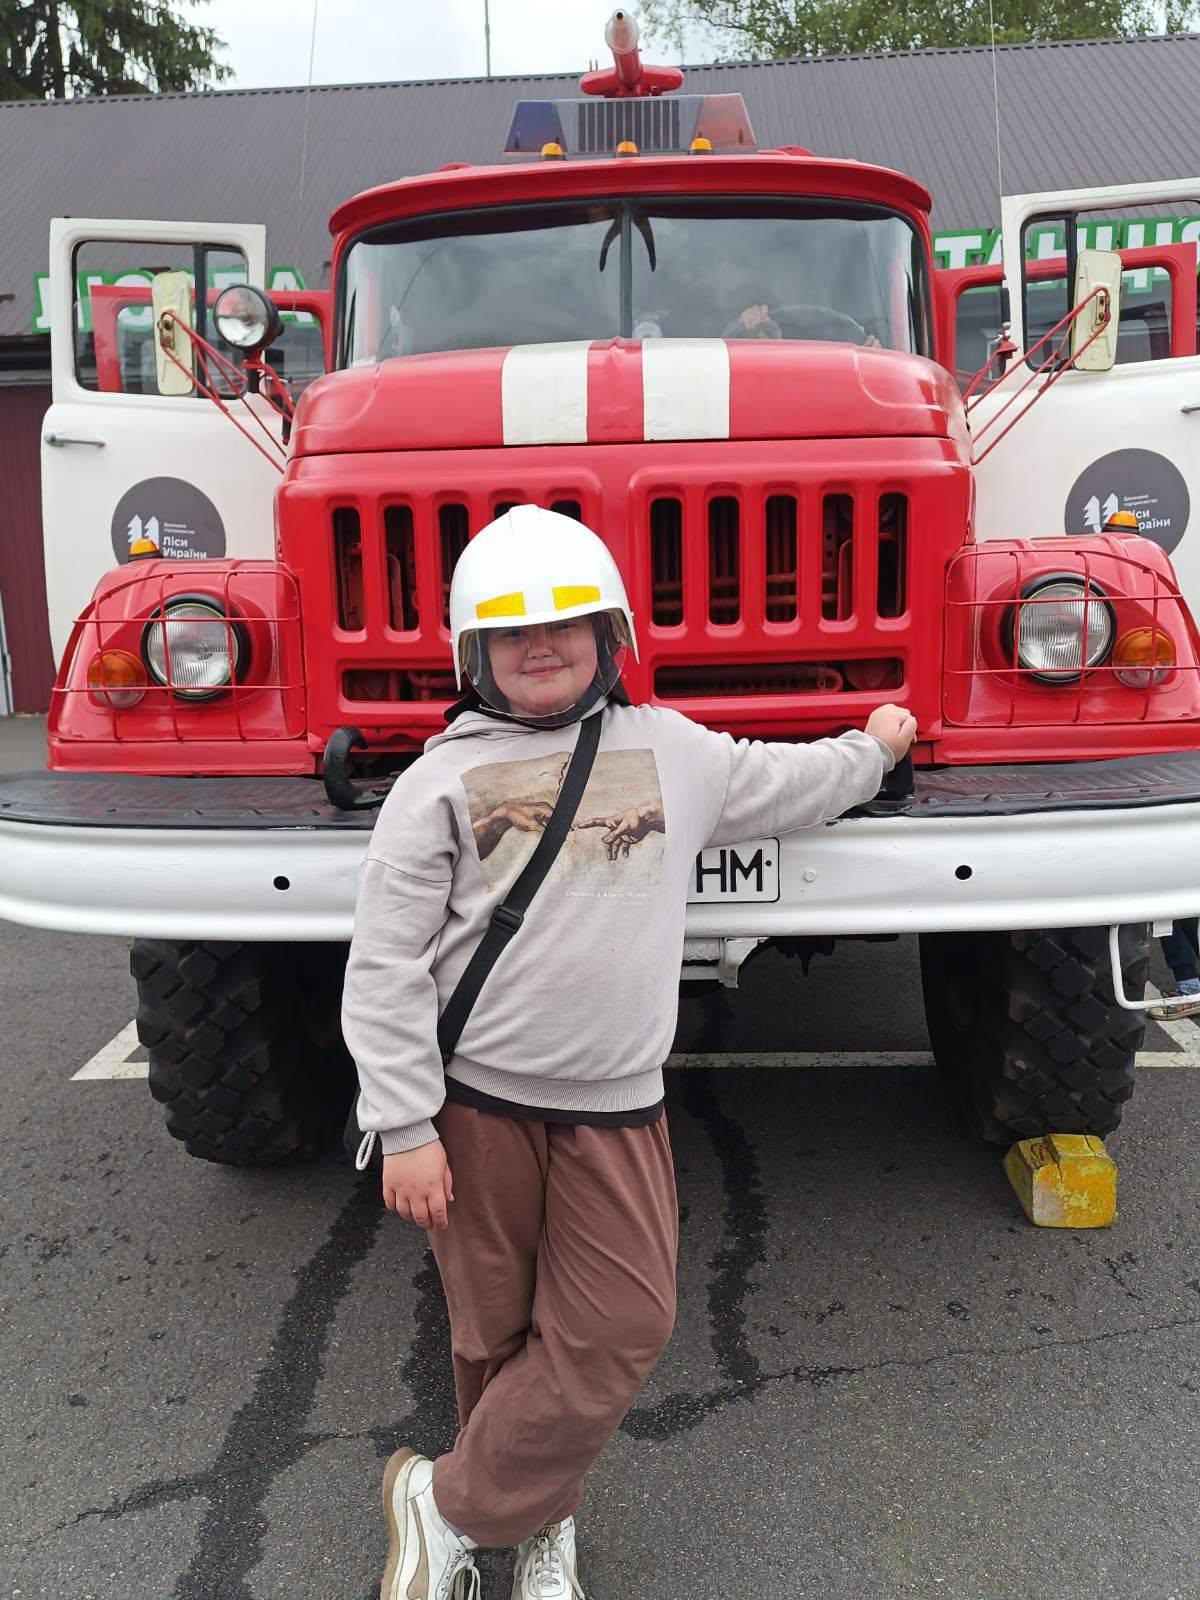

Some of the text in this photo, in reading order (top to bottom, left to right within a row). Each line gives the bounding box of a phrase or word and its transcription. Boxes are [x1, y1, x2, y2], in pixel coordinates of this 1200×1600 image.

[1138, 518, 1171, 532] раїни
[163, 536, 188, 547] Ліси
[163, 547, 207, 560] України
